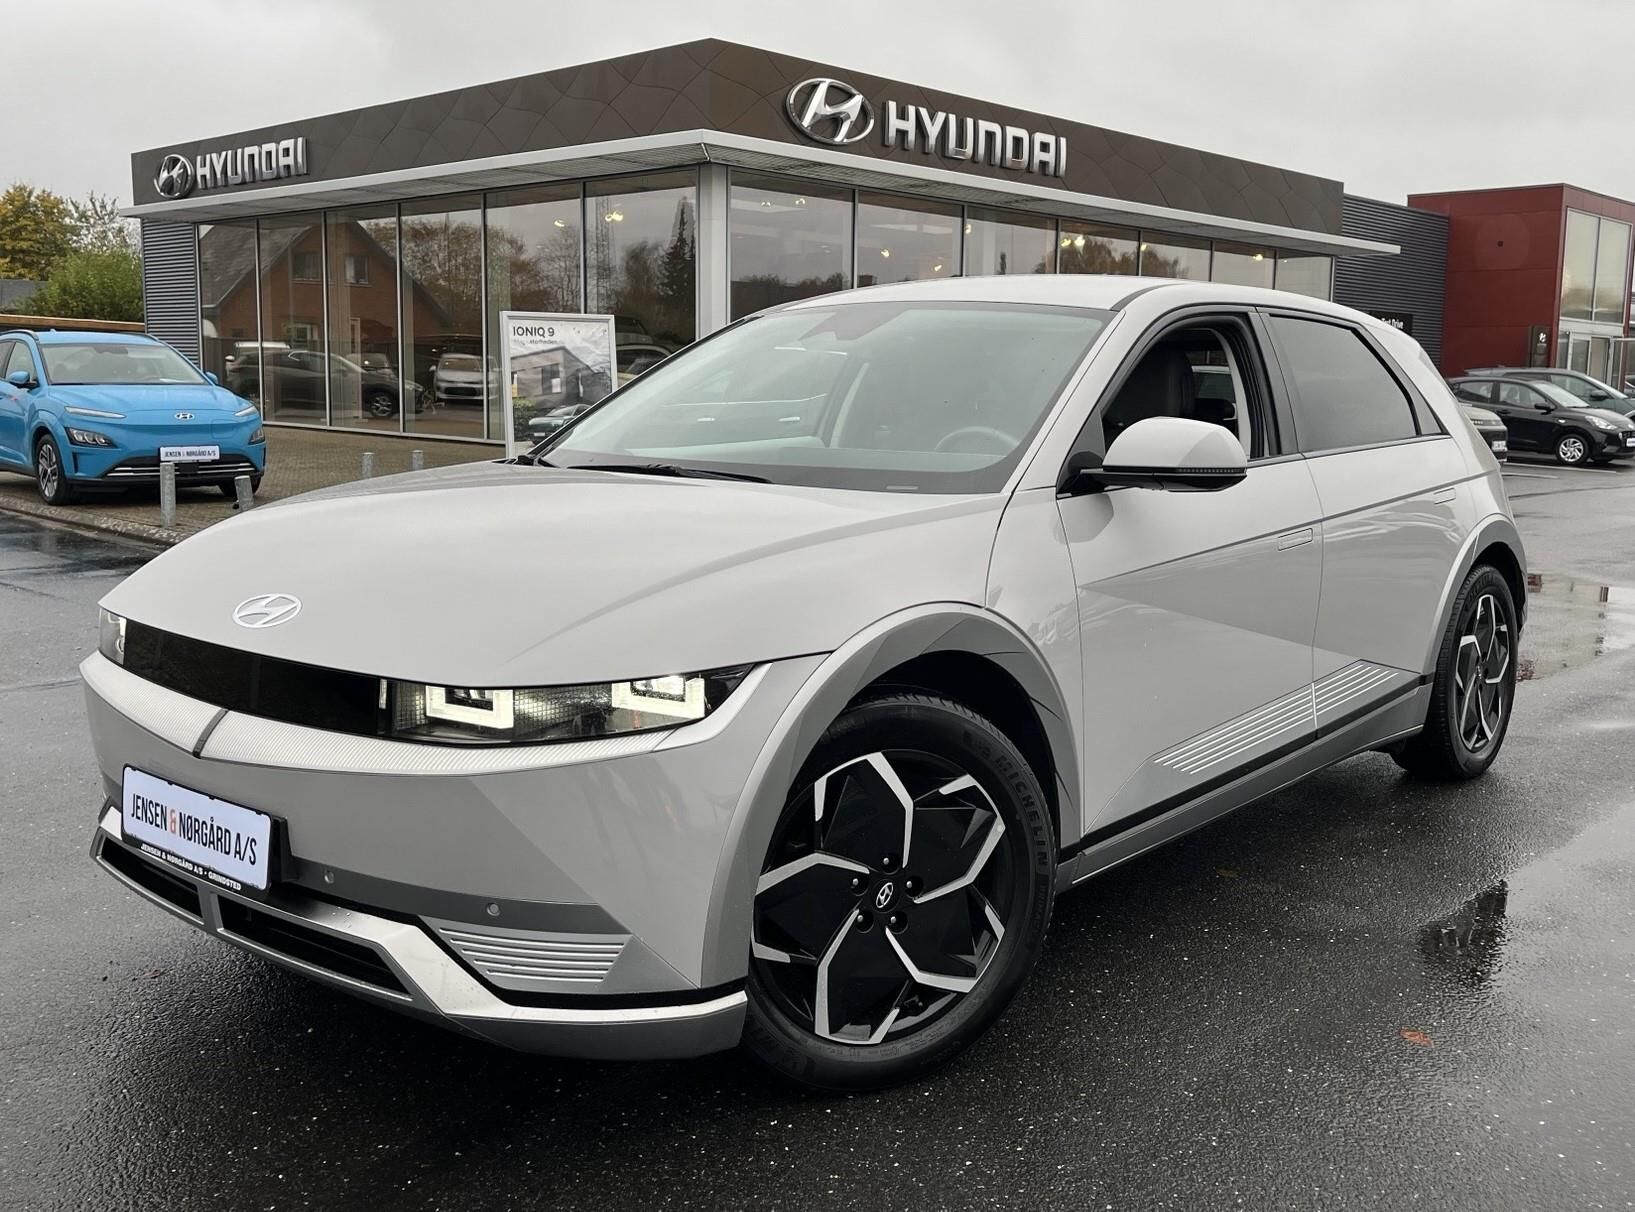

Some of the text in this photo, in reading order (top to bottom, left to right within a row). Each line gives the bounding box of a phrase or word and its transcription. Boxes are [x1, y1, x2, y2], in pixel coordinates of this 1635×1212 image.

[196, 137, 308, 190] HYUNDAI
[885, 99, 1067, 177] HYUNDAI
[512, 325, 555, 338] IONIQ 9
[131, 793, 257, 866] JENSEN & NØRGÅRD A/S
[996, 756, 1049, 866] MICHELIN
